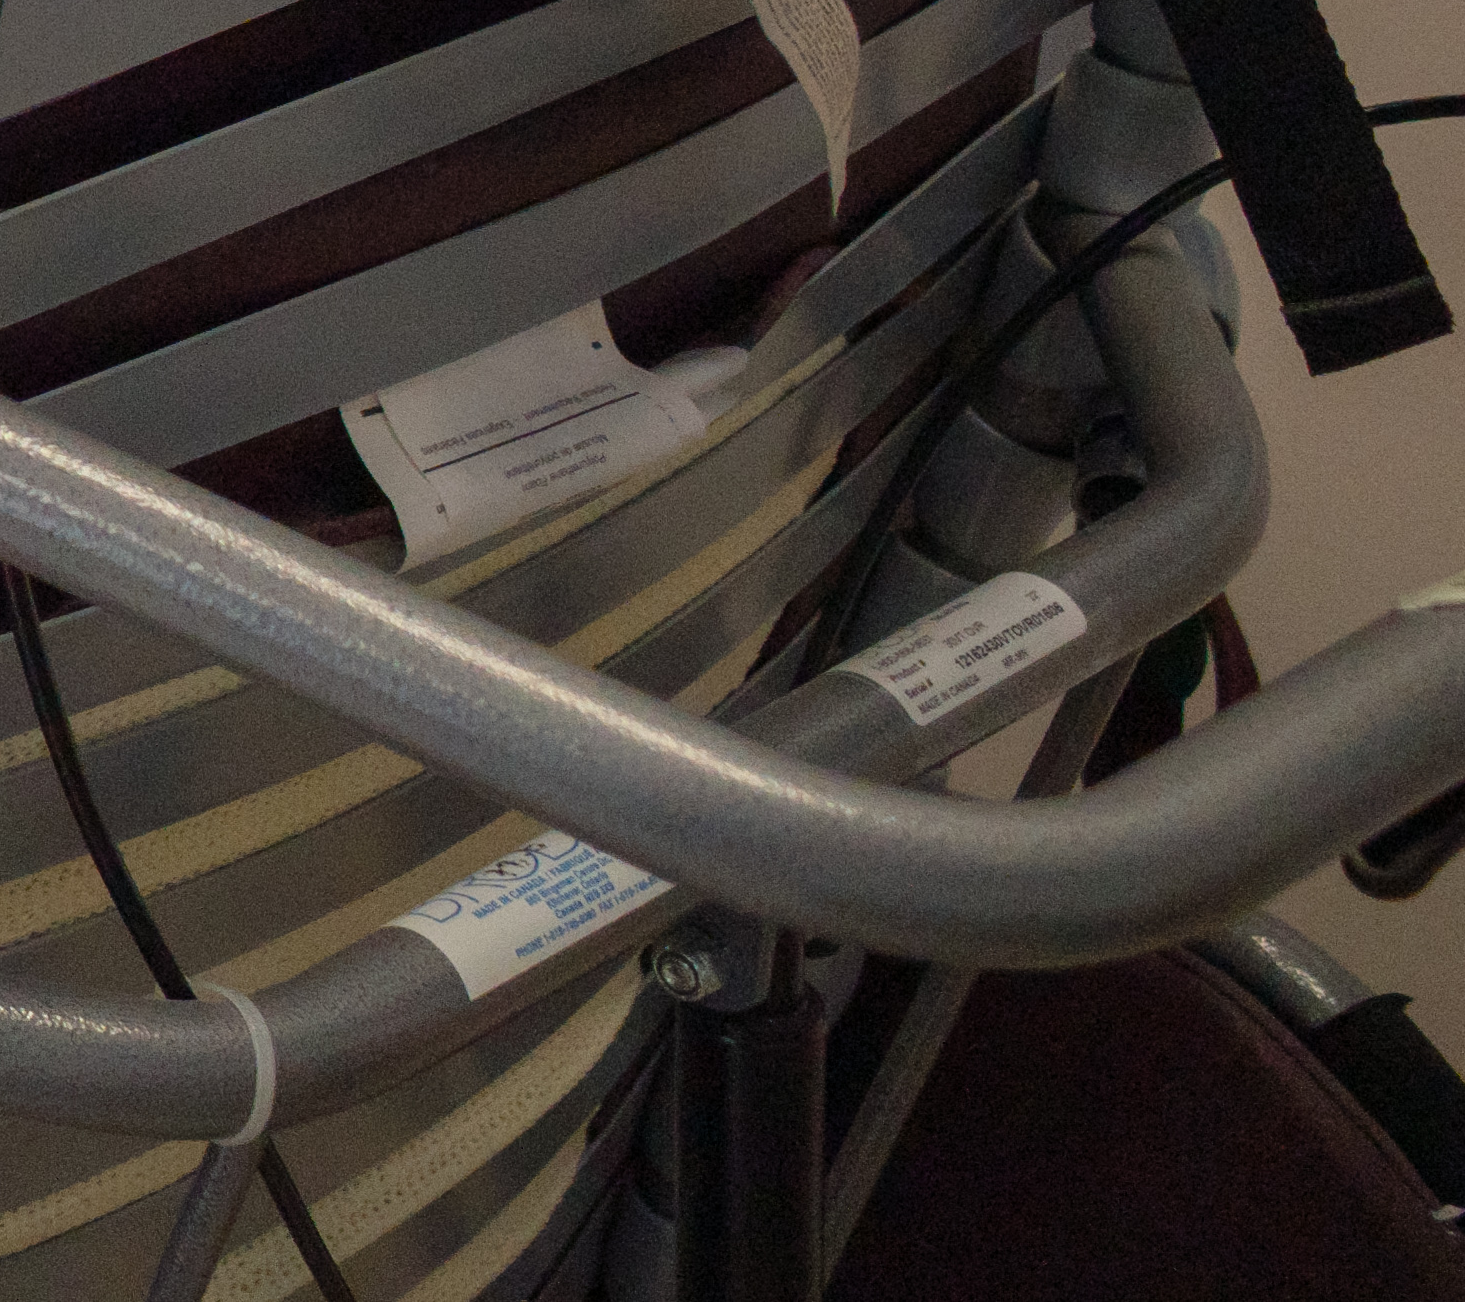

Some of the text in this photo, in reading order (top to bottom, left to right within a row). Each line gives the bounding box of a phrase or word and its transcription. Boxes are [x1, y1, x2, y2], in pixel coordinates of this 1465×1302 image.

[917, 695, 941, 714] MADE
[939, 691, 951, 700] IN
[948, 673, 980, 696] CANADA
[472, 899, 501, 919] MADE
[498, 895, 511, 904] IN
[508, 875, 546, 898] CANADA
